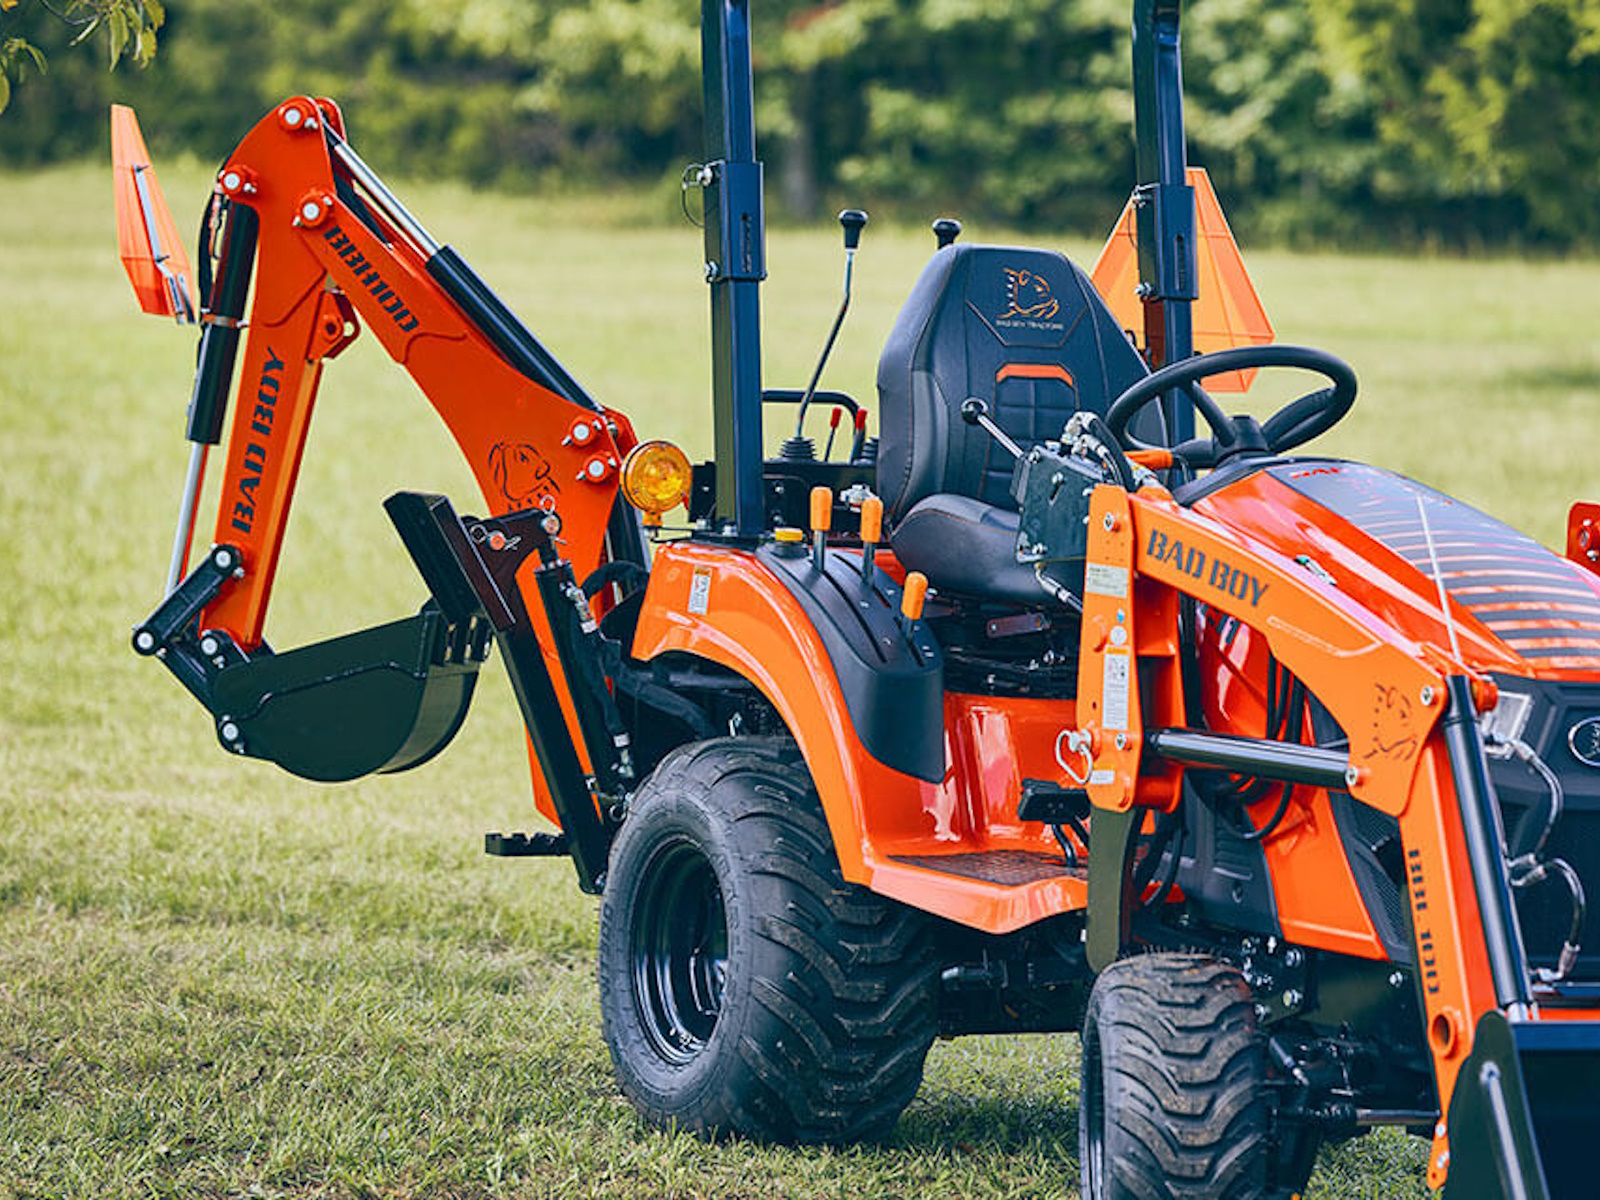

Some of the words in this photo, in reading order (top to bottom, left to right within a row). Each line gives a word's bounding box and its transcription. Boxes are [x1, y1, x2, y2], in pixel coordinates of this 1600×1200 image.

[323, 225, 420, 333] BBH100
[231, 442, 267, 534] BAD
[251, 345, 285, 436] BOY
[1146, 527, 1206, 580] BAD
[1208, 558, 1270, 607] BOY
